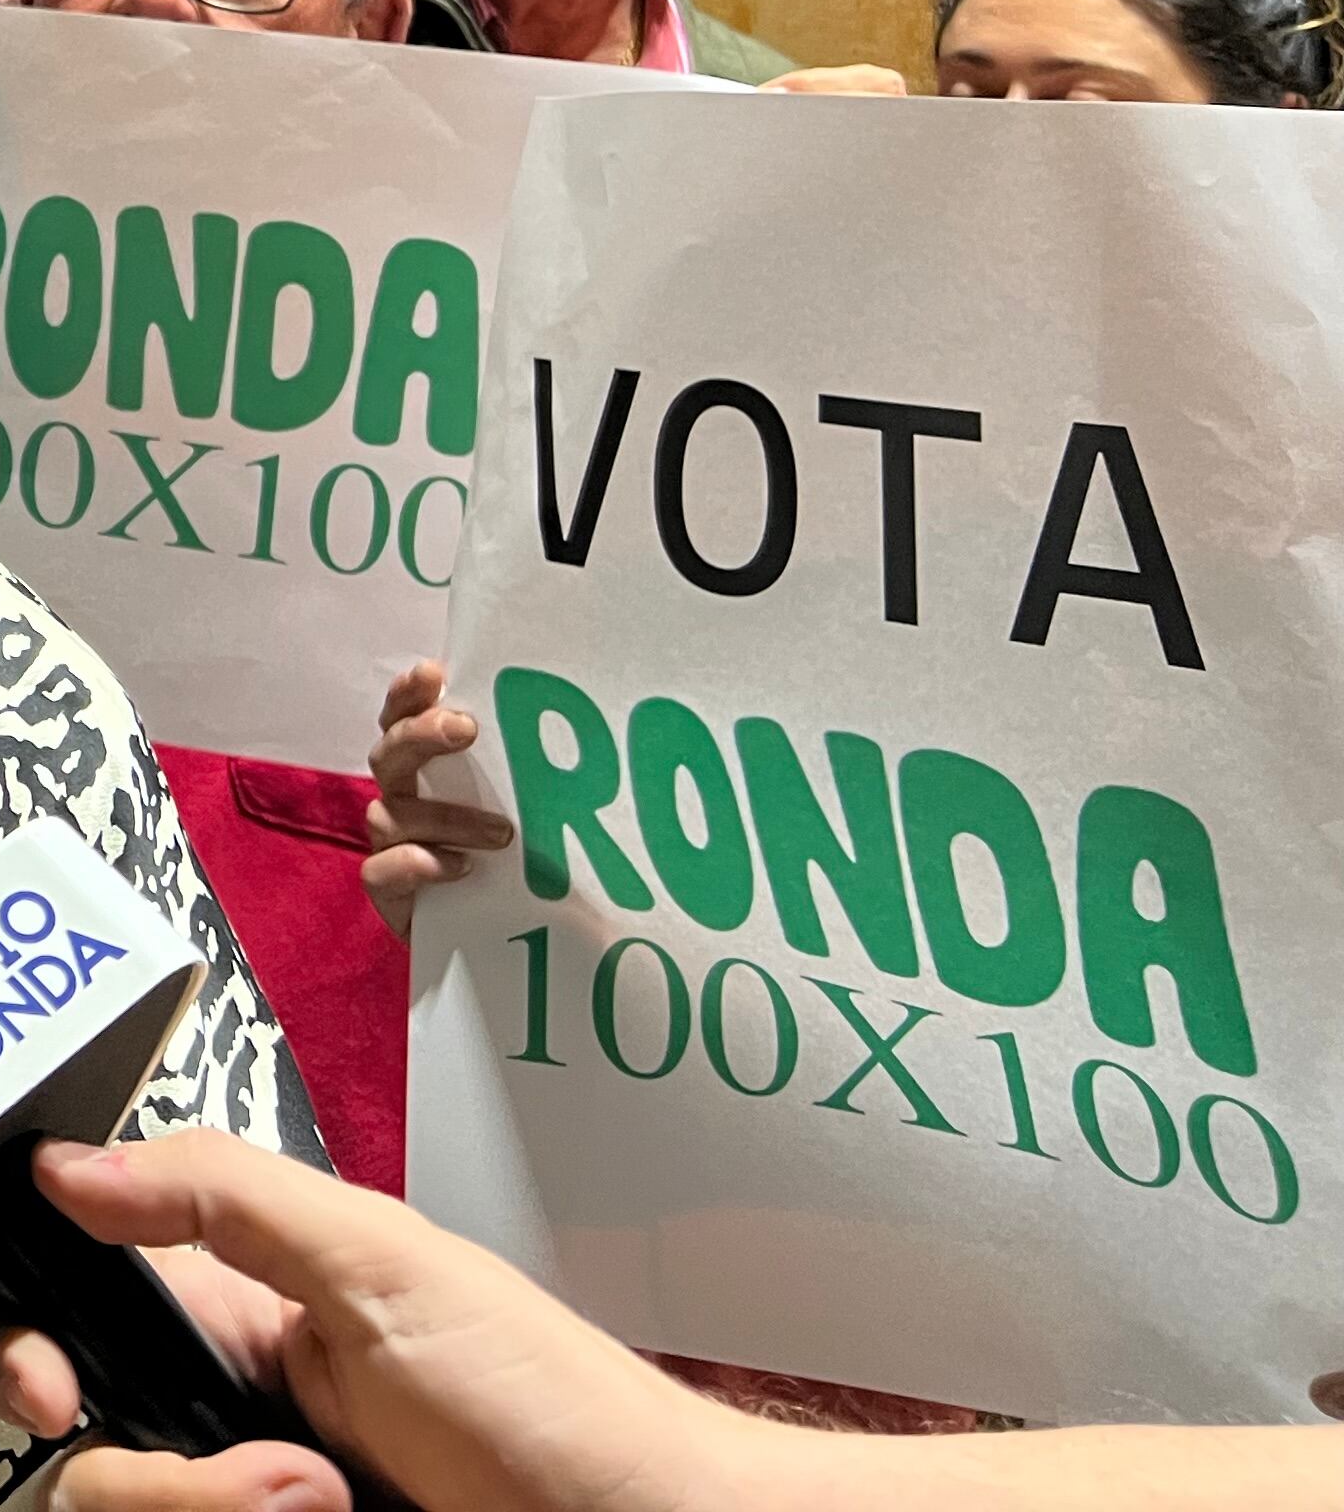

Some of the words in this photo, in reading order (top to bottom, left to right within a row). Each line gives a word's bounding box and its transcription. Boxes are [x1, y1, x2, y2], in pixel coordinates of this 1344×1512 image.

[532, 356, 1207, 673] VOTA
[494, 665, 1259, 1078] RONDA
[505, 924, 1301, 1226] 100X100
